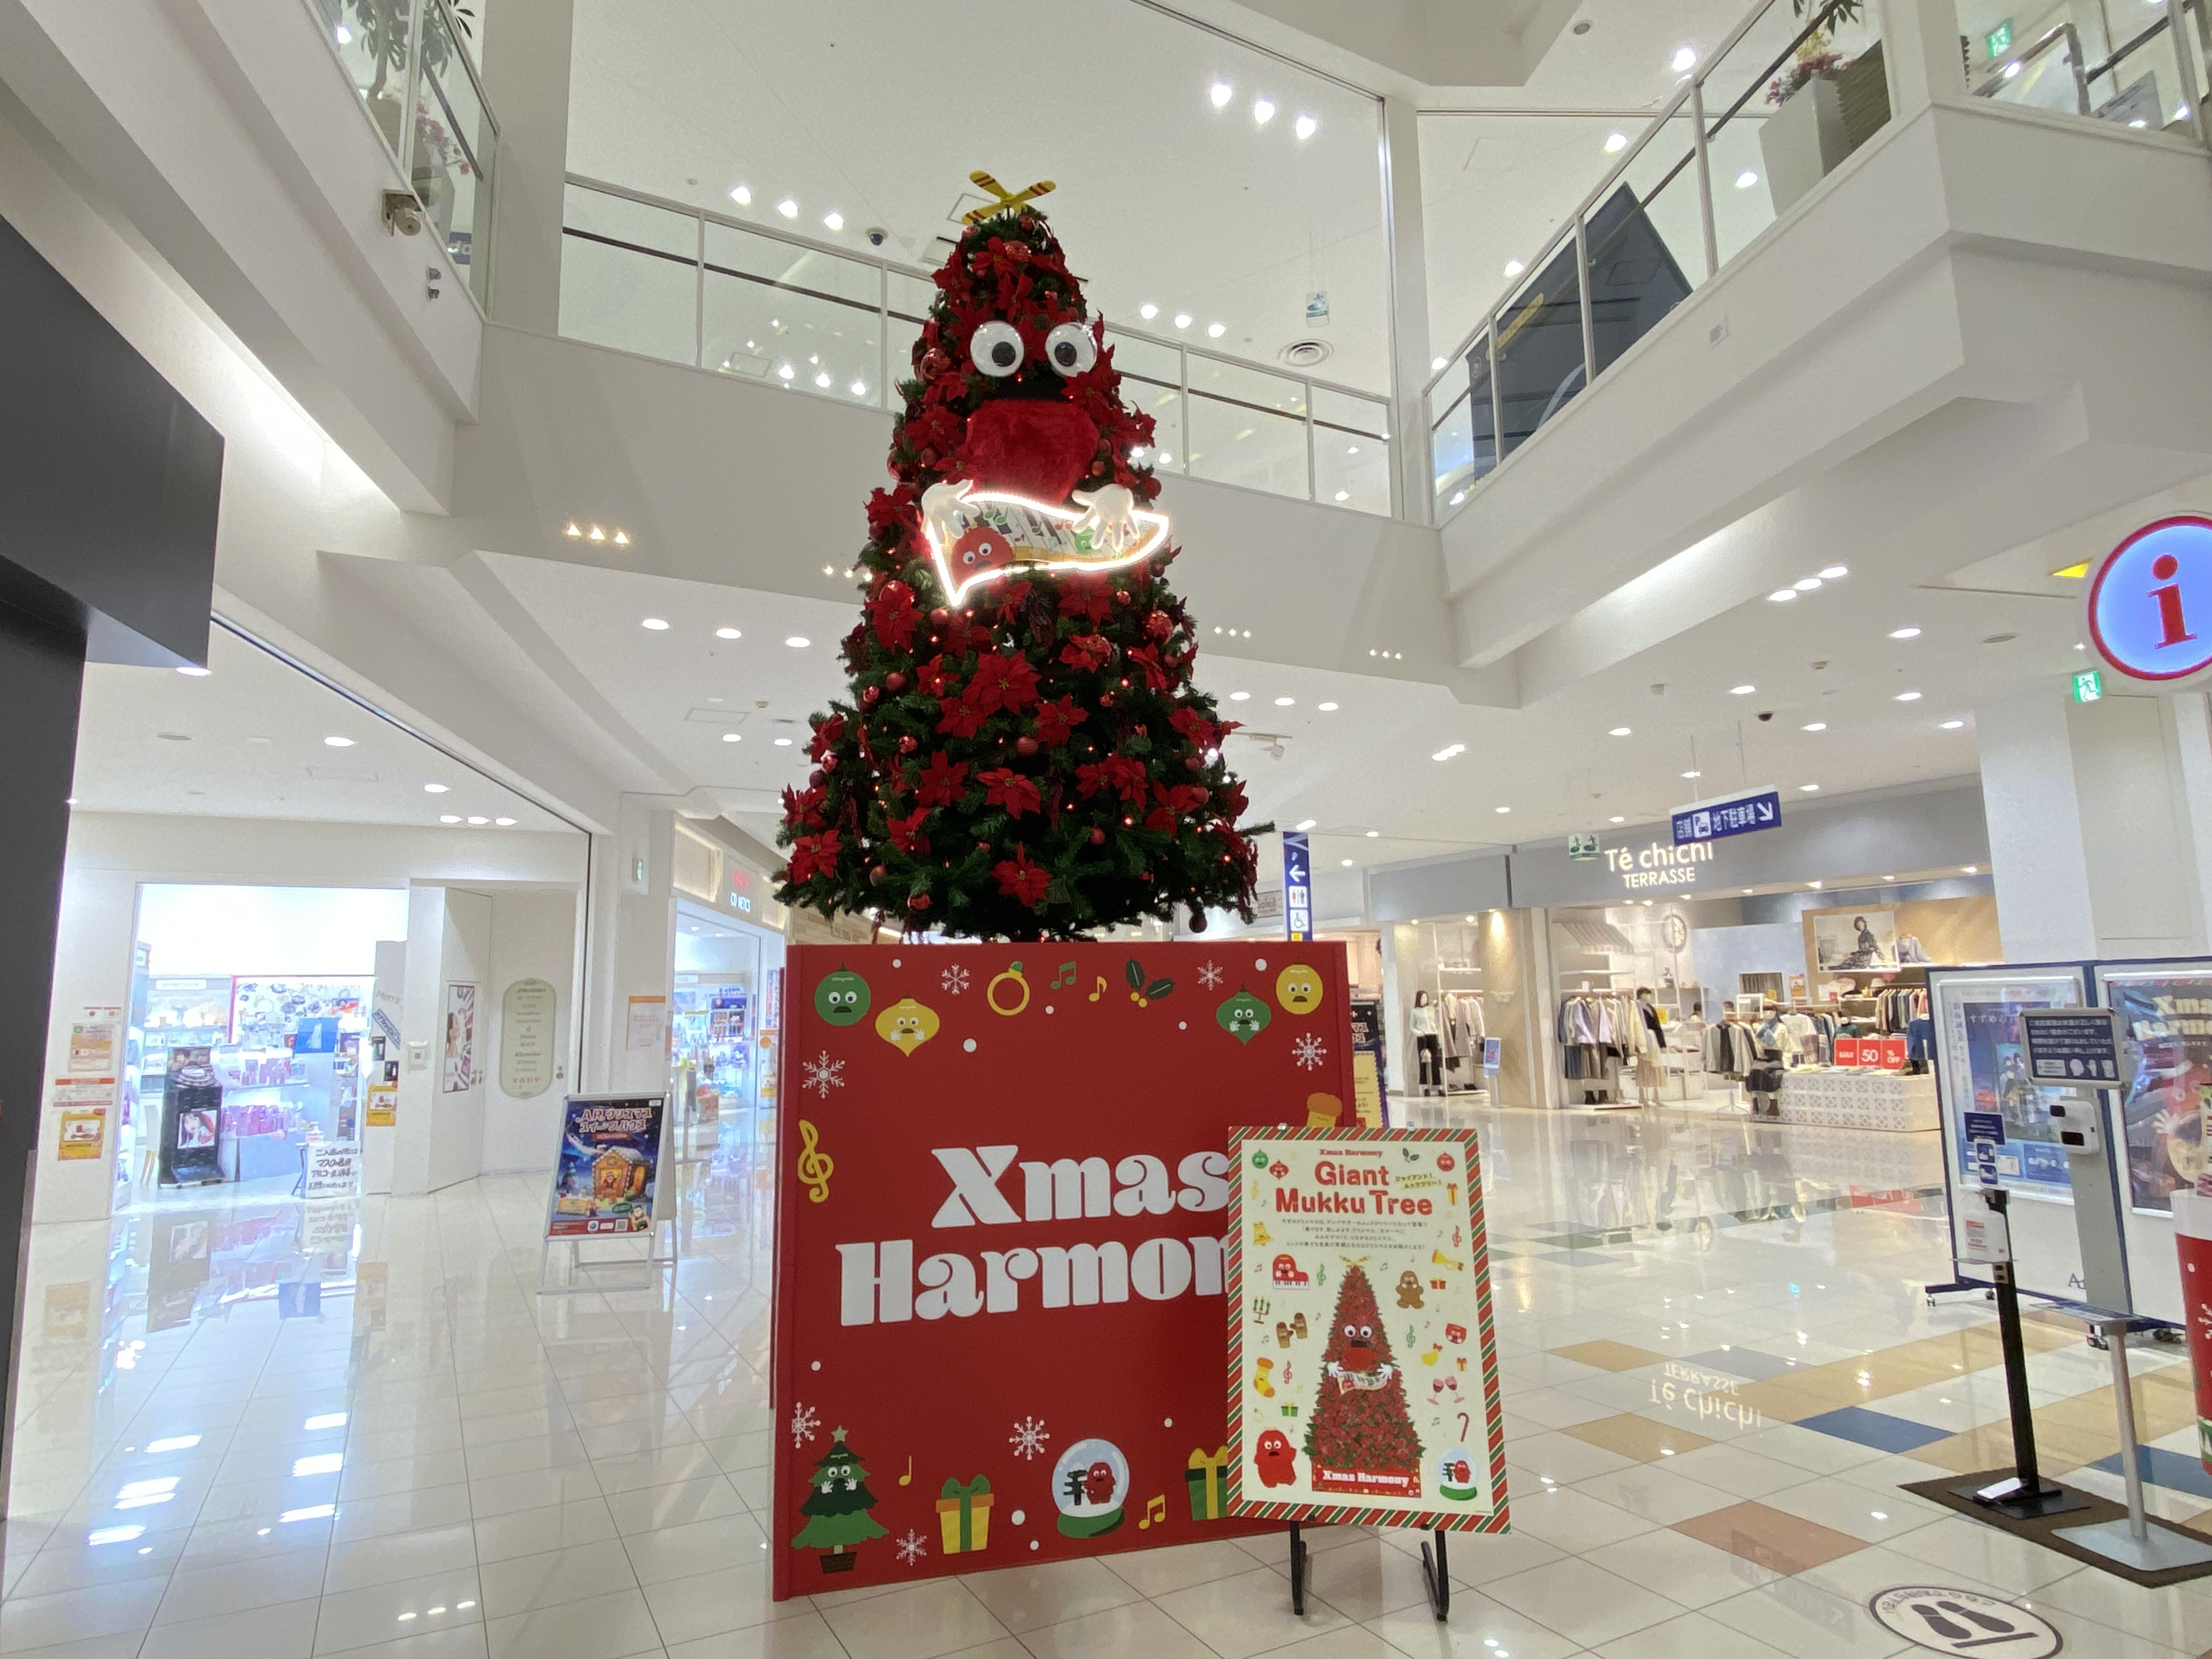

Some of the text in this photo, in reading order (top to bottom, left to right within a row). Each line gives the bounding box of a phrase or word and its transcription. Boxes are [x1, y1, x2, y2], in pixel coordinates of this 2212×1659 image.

[1604, 842, 1713, 872] Té chichi
[1622, 866, 1696, 889] TERRASSE
[1861, 1049, 1878, 1062] 50
[931, 1144, 1229, 1228] Xmas
[1314, 1160, 1390, 1186] Giant
[1275, 1188, 1433, 1216] Mukku Tree
[834, 1235, 1229, 1327] Harmon
[1323, 1470, 1409, 1488] Xmas Harmony
